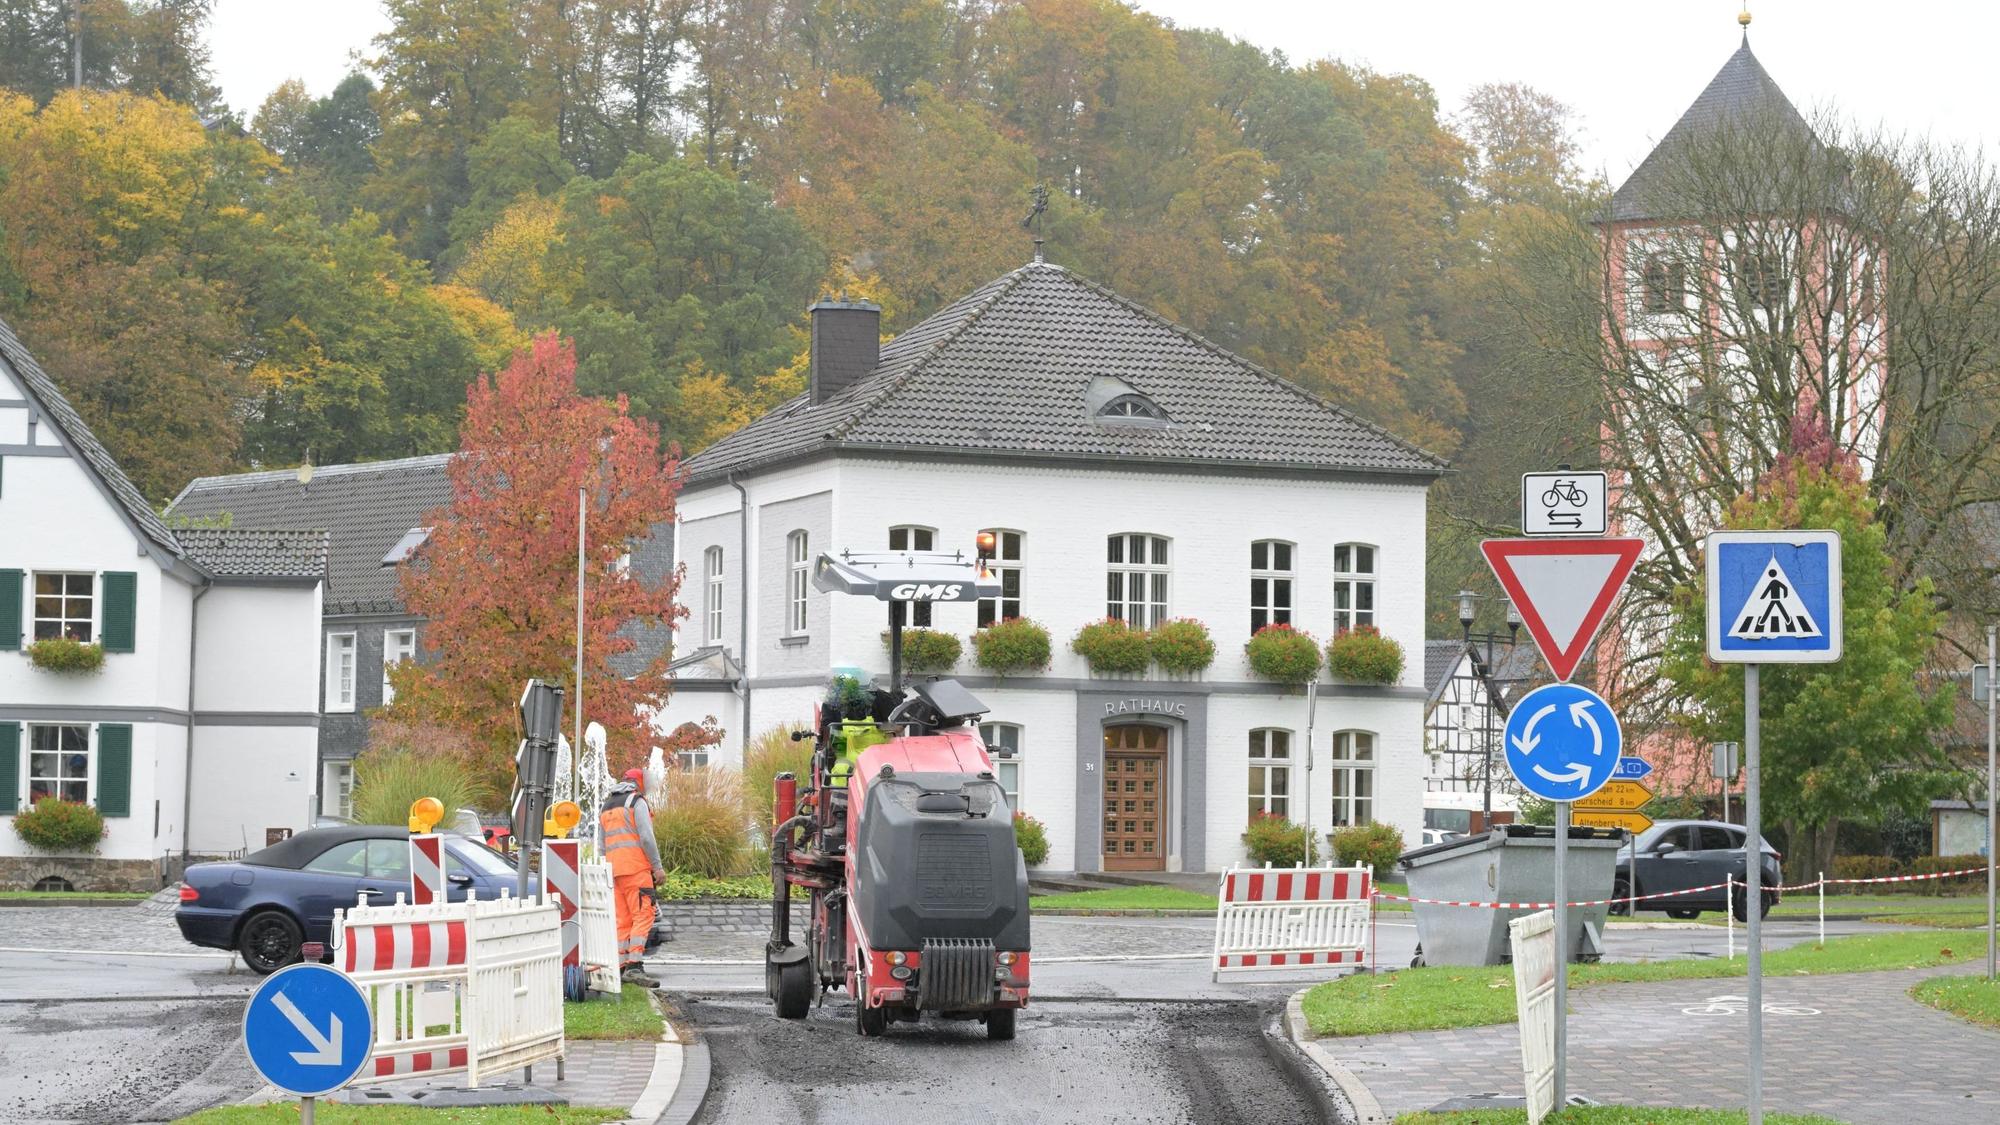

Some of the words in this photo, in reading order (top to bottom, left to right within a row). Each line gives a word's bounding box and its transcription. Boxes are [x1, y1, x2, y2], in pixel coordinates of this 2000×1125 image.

[891, 584, 963, 600] GMS
[1105, 699, 1186, 716] RATHAUS
[1616, 784, 1625, 793] 22
[1579, 818, 1615, 827] Altenberg
[1618, 819, 1623, 827] 3
